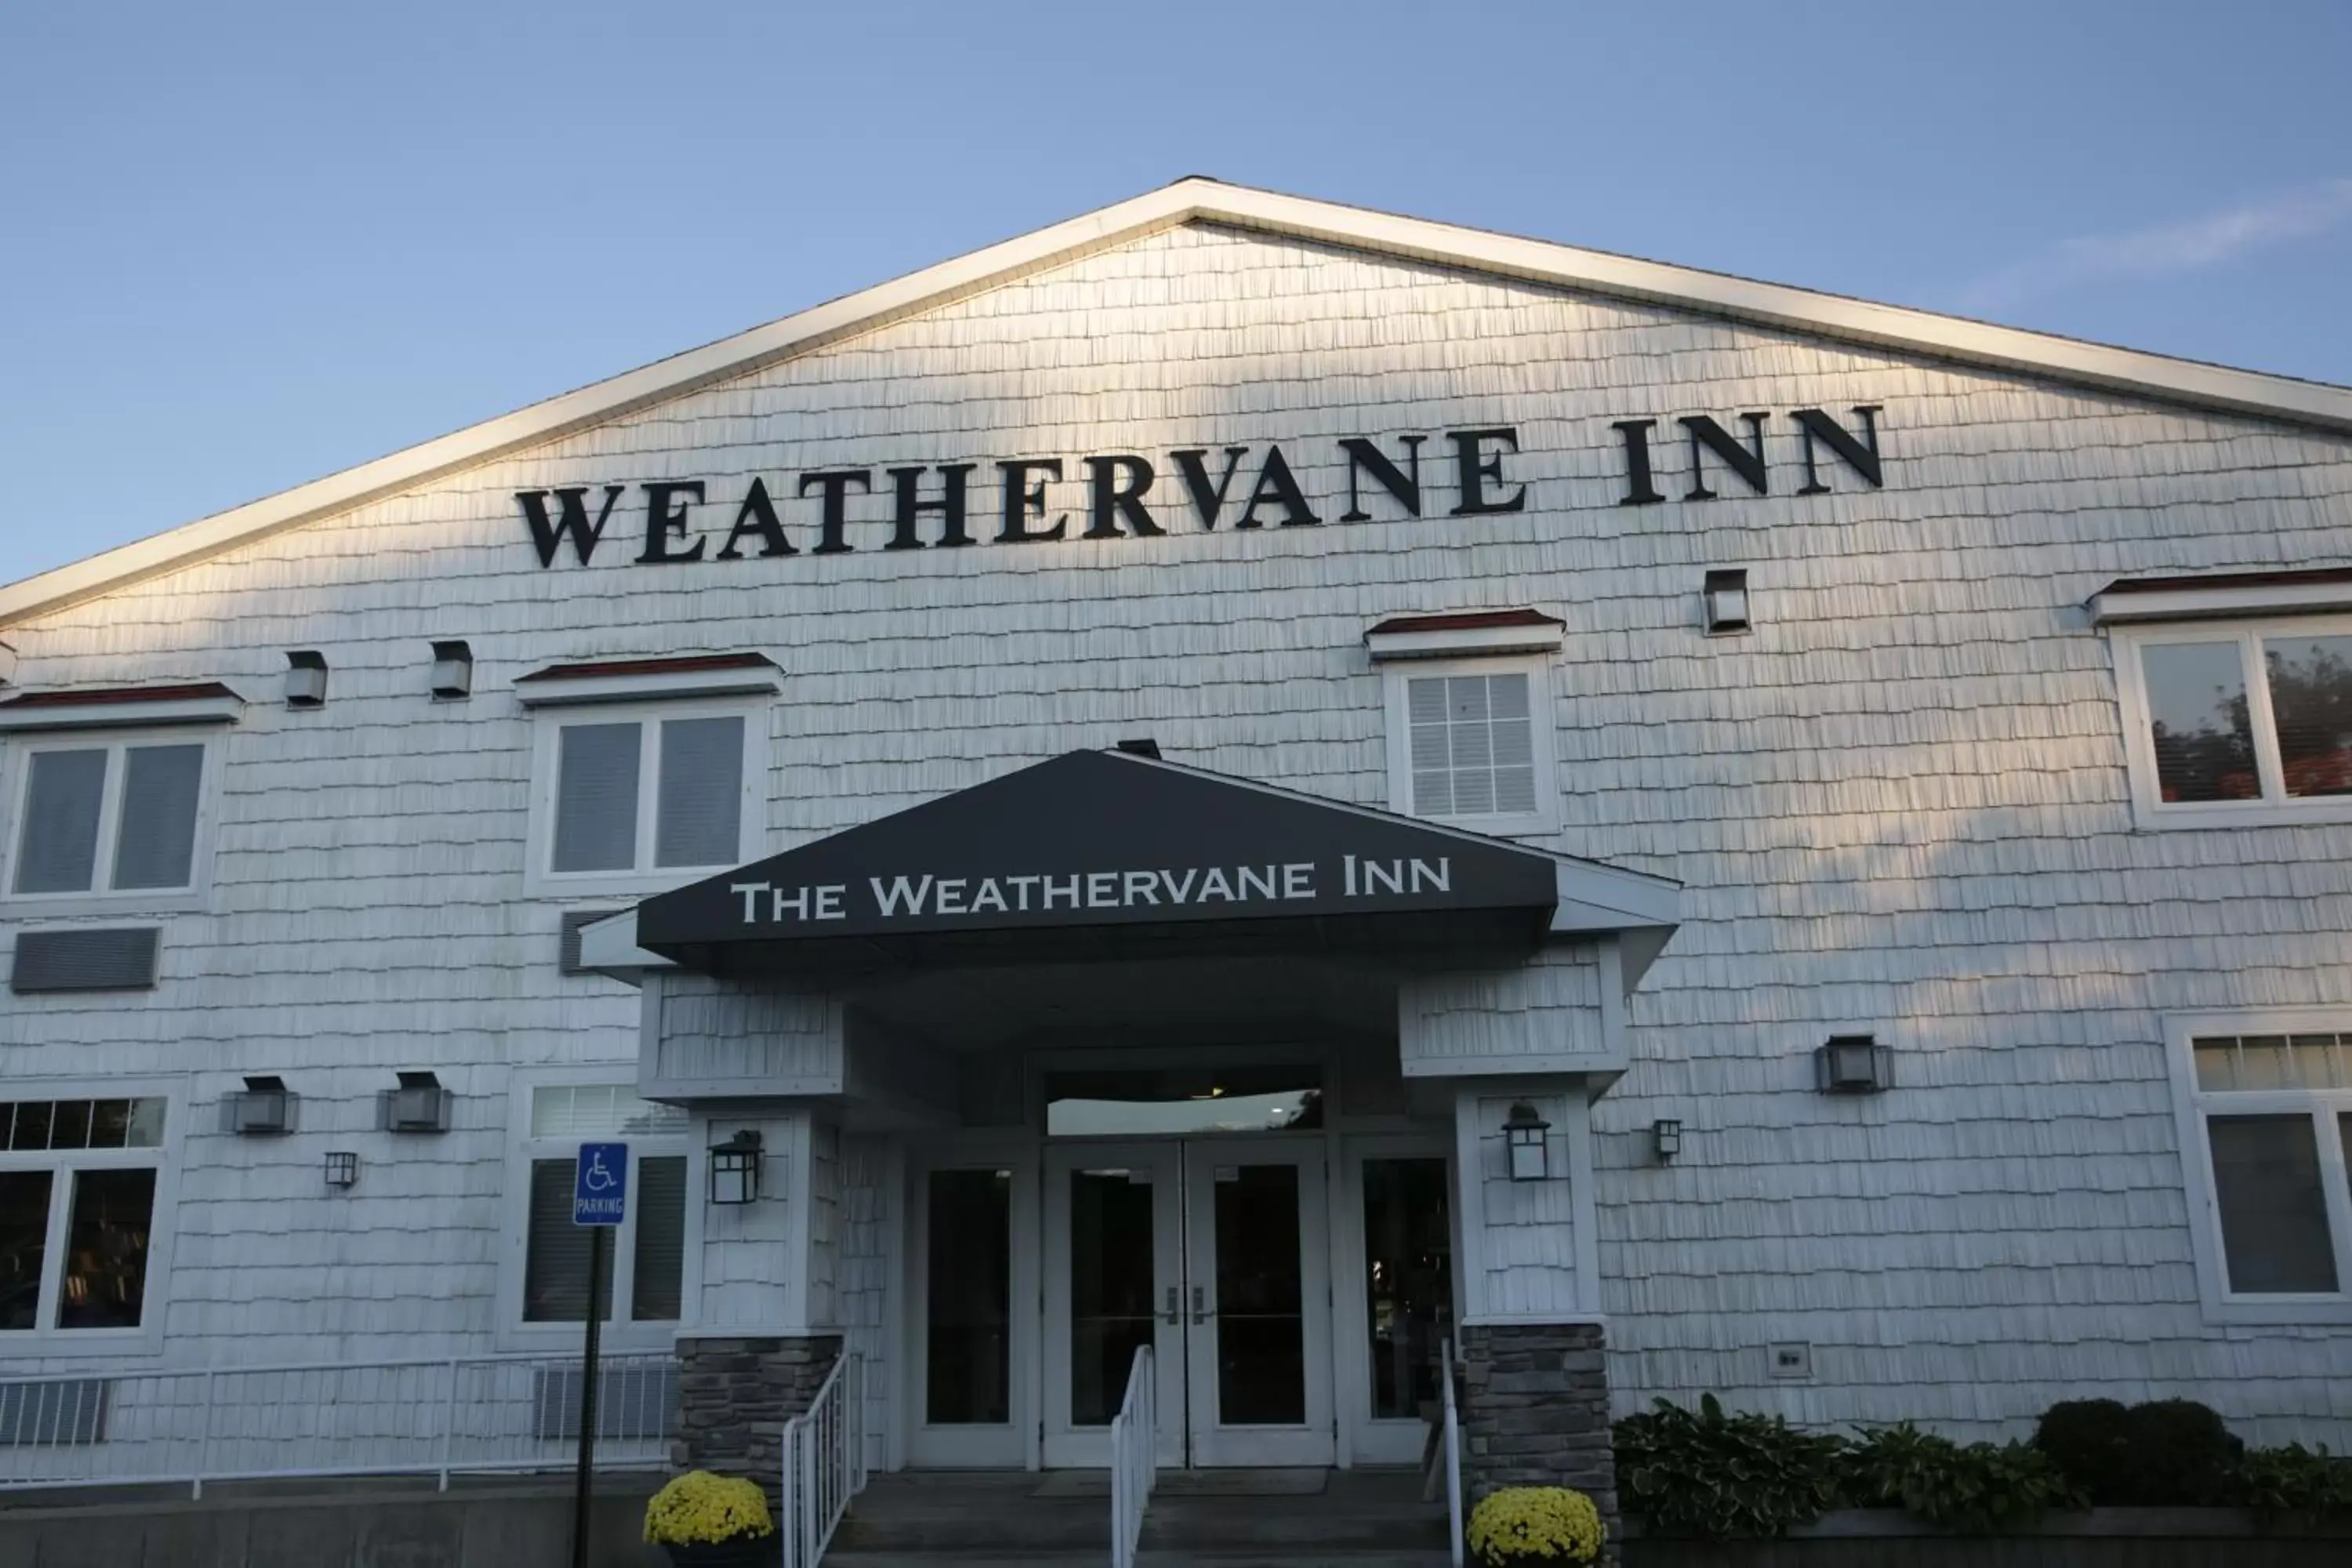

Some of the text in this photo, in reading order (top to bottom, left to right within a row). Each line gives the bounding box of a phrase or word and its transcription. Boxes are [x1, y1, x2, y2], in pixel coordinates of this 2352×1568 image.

[514, 405, 1886, 567] WEATHERVANE INN
[731, 855, 1451, 924] THE WEATHERVANE INN
[576, 1197, 623, 1214] PARKING
